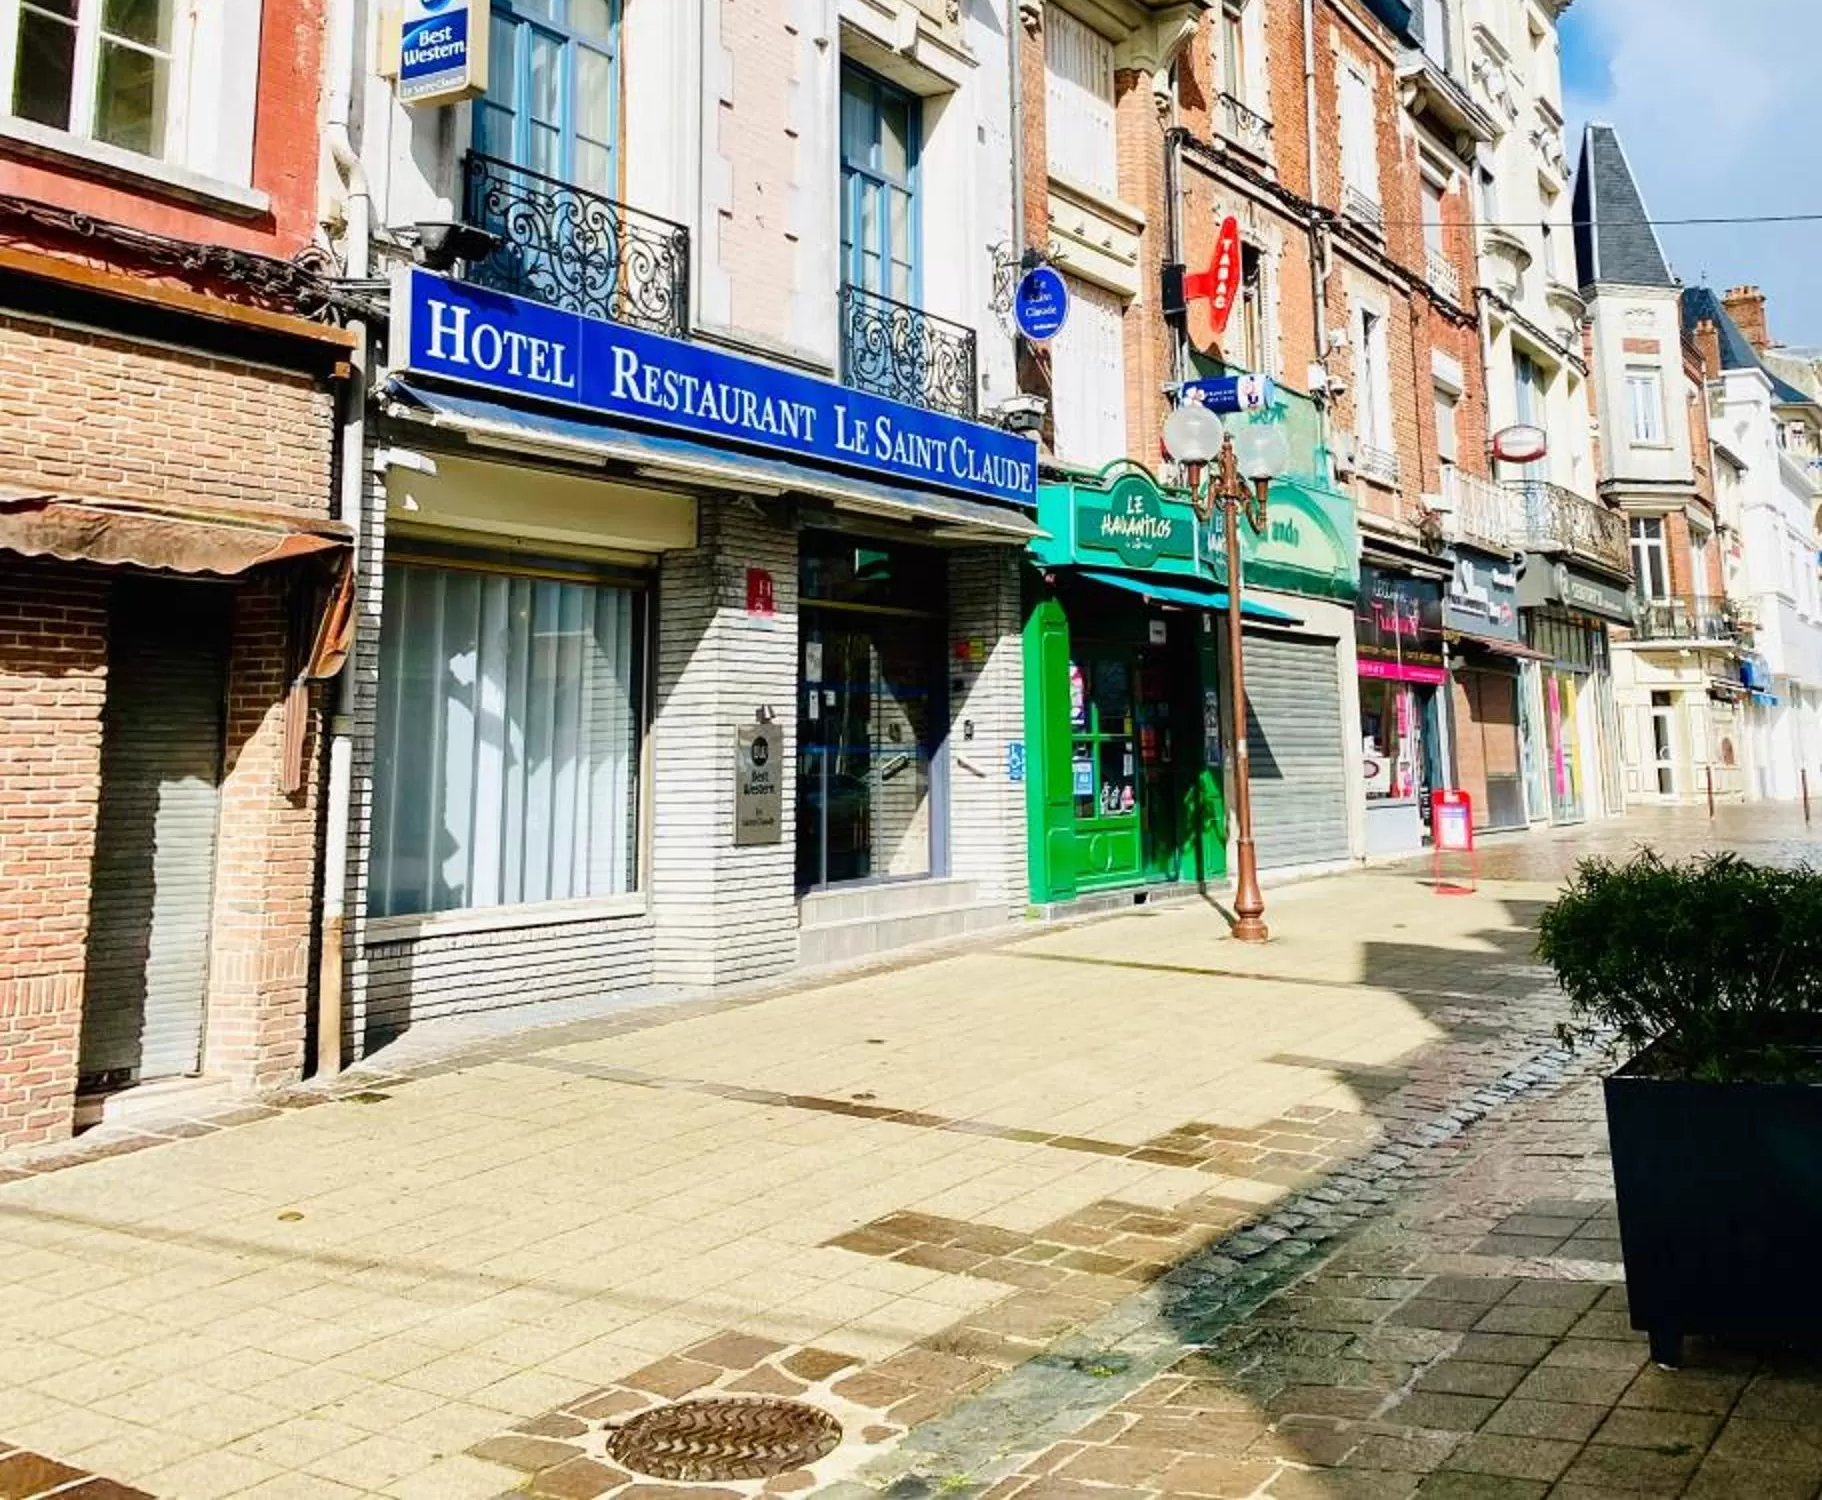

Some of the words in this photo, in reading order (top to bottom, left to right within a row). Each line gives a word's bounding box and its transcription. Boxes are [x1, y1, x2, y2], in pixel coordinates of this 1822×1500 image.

[419, 25, 452, 47] Best
[403, 40, 465, 67] Western
[1214, 238, 1233, 310] TABAC
[426, 298, 576, 389] HOTEL
[610, 346, 818, 442] RESTAURANT
[875, 415, 947, 473] SAINT
[950, 436, 1033, 494] CLAUDE
[1126, 493, 1145, 515] LE
